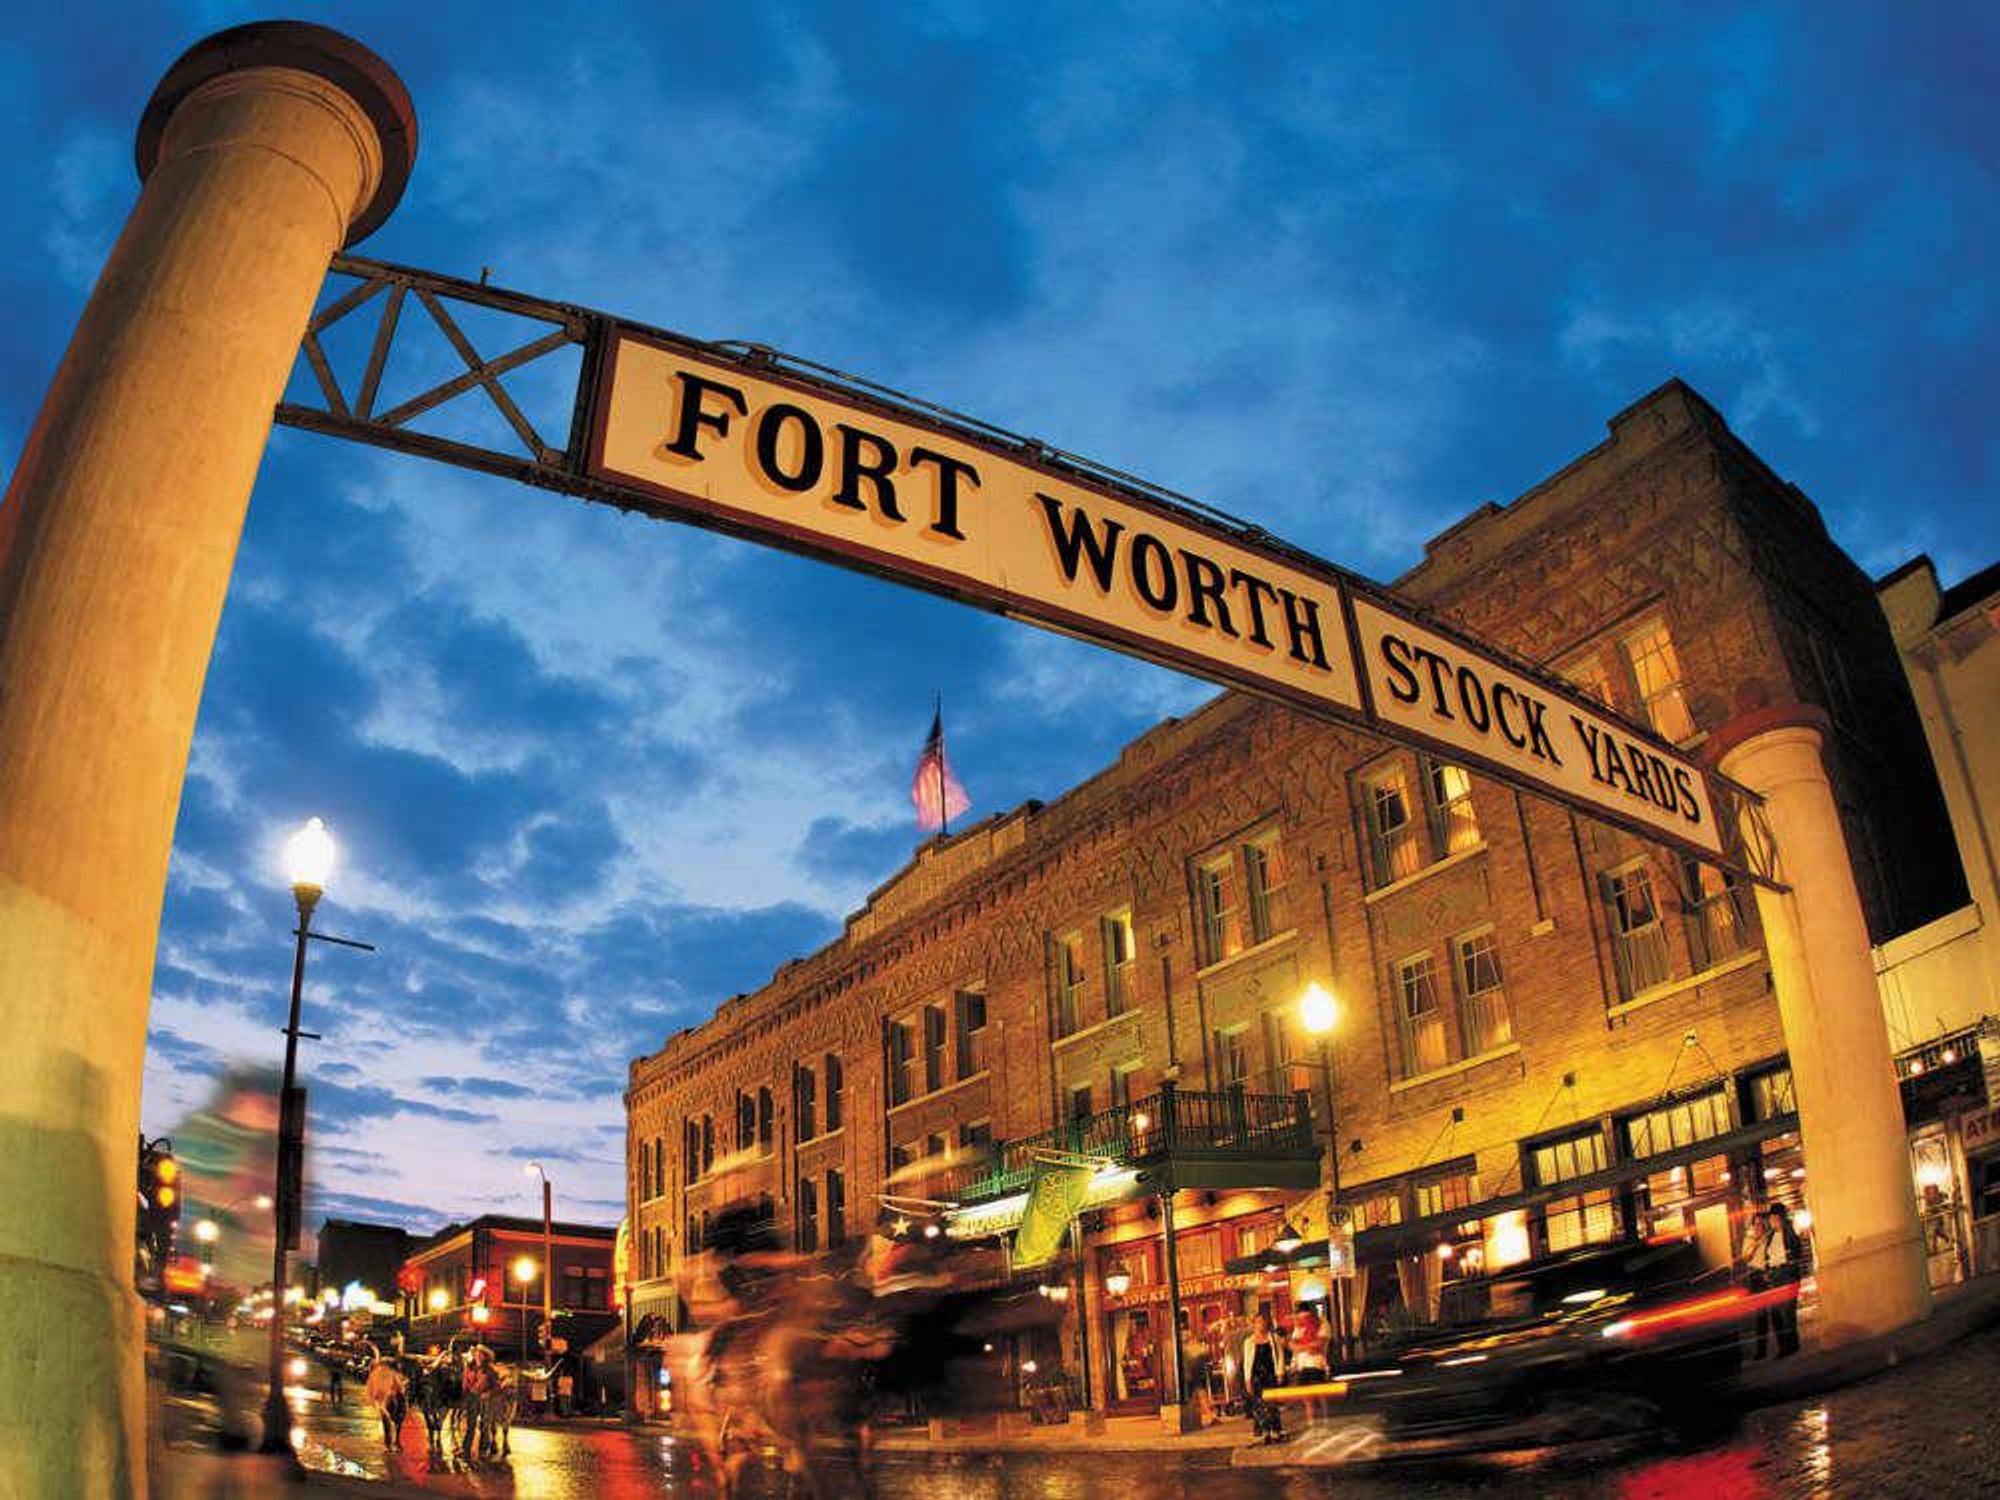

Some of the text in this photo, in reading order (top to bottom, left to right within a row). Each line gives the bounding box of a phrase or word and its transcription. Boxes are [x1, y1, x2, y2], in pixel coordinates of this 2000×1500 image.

[664, 370, 1701, 824] FORT WORTH STOCK YARDS
